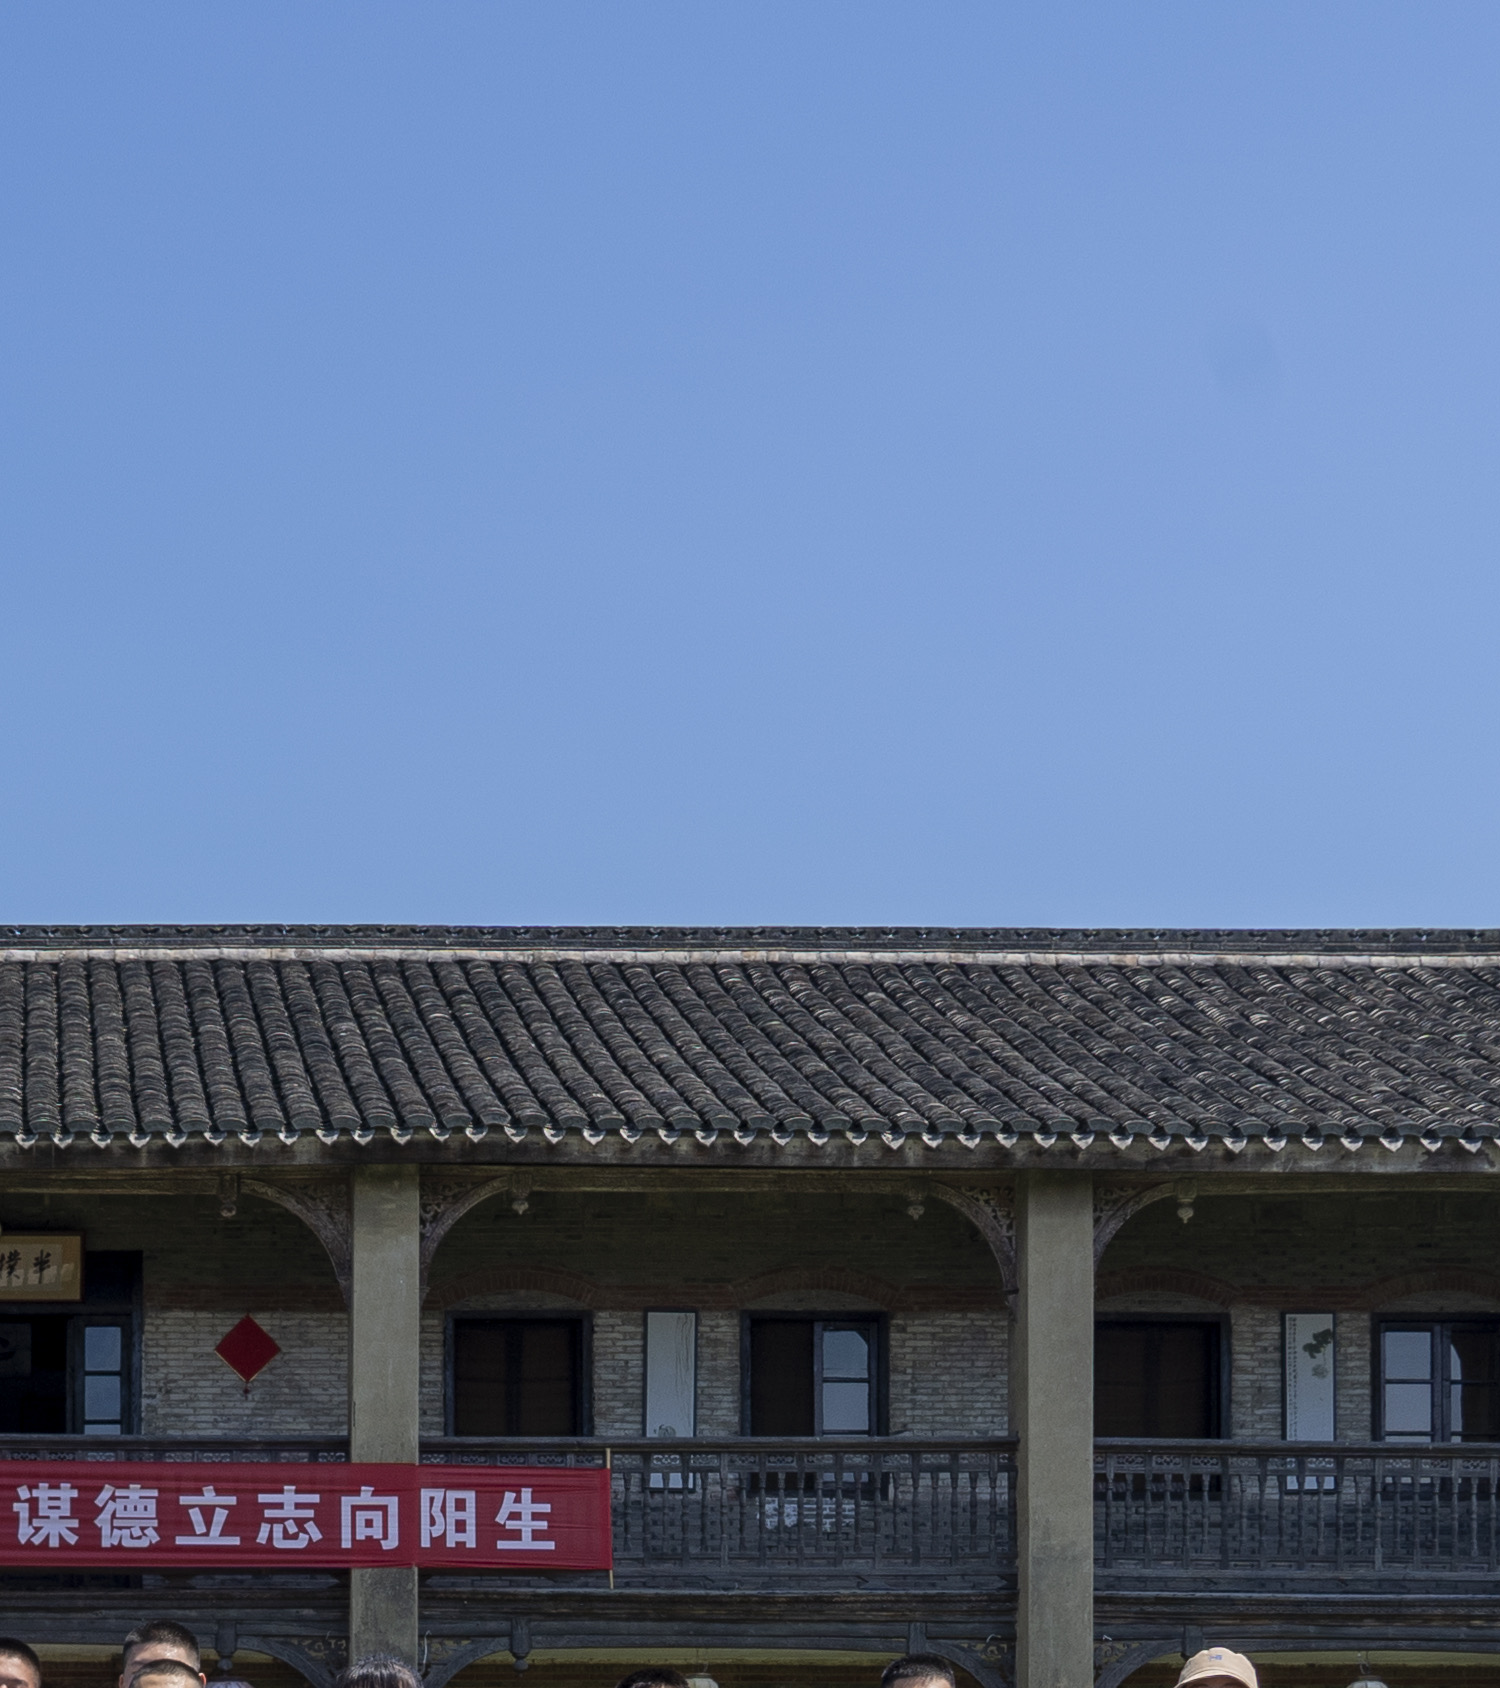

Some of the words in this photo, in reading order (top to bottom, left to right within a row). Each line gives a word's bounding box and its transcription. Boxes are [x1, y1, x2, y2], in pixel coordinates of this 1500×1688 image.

[12, 1483, 557, 1552] 谋德立志向阳生
